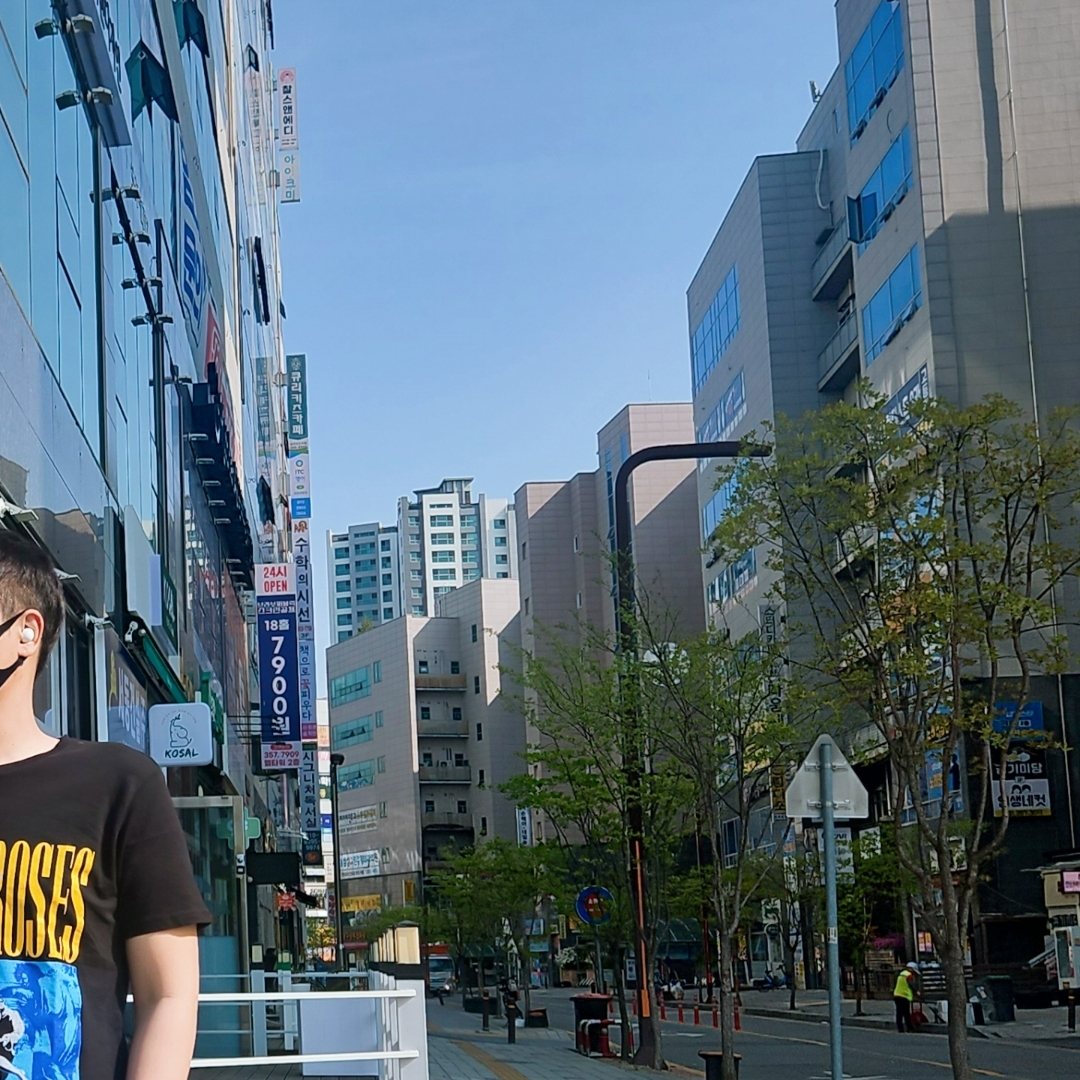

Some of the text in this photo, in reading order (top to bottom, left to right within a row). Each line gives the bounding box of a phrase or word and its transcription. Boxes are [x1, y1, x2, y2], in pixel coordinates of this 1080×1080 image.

[263, 565, 287, 578] 24시
[264, 580, 288, 593] OPEN
[264, 619, 289, 632] 18홀
[165, 748, 199, 759] KOSAL
[302, 752, 317, 828] 시그니처독서실
